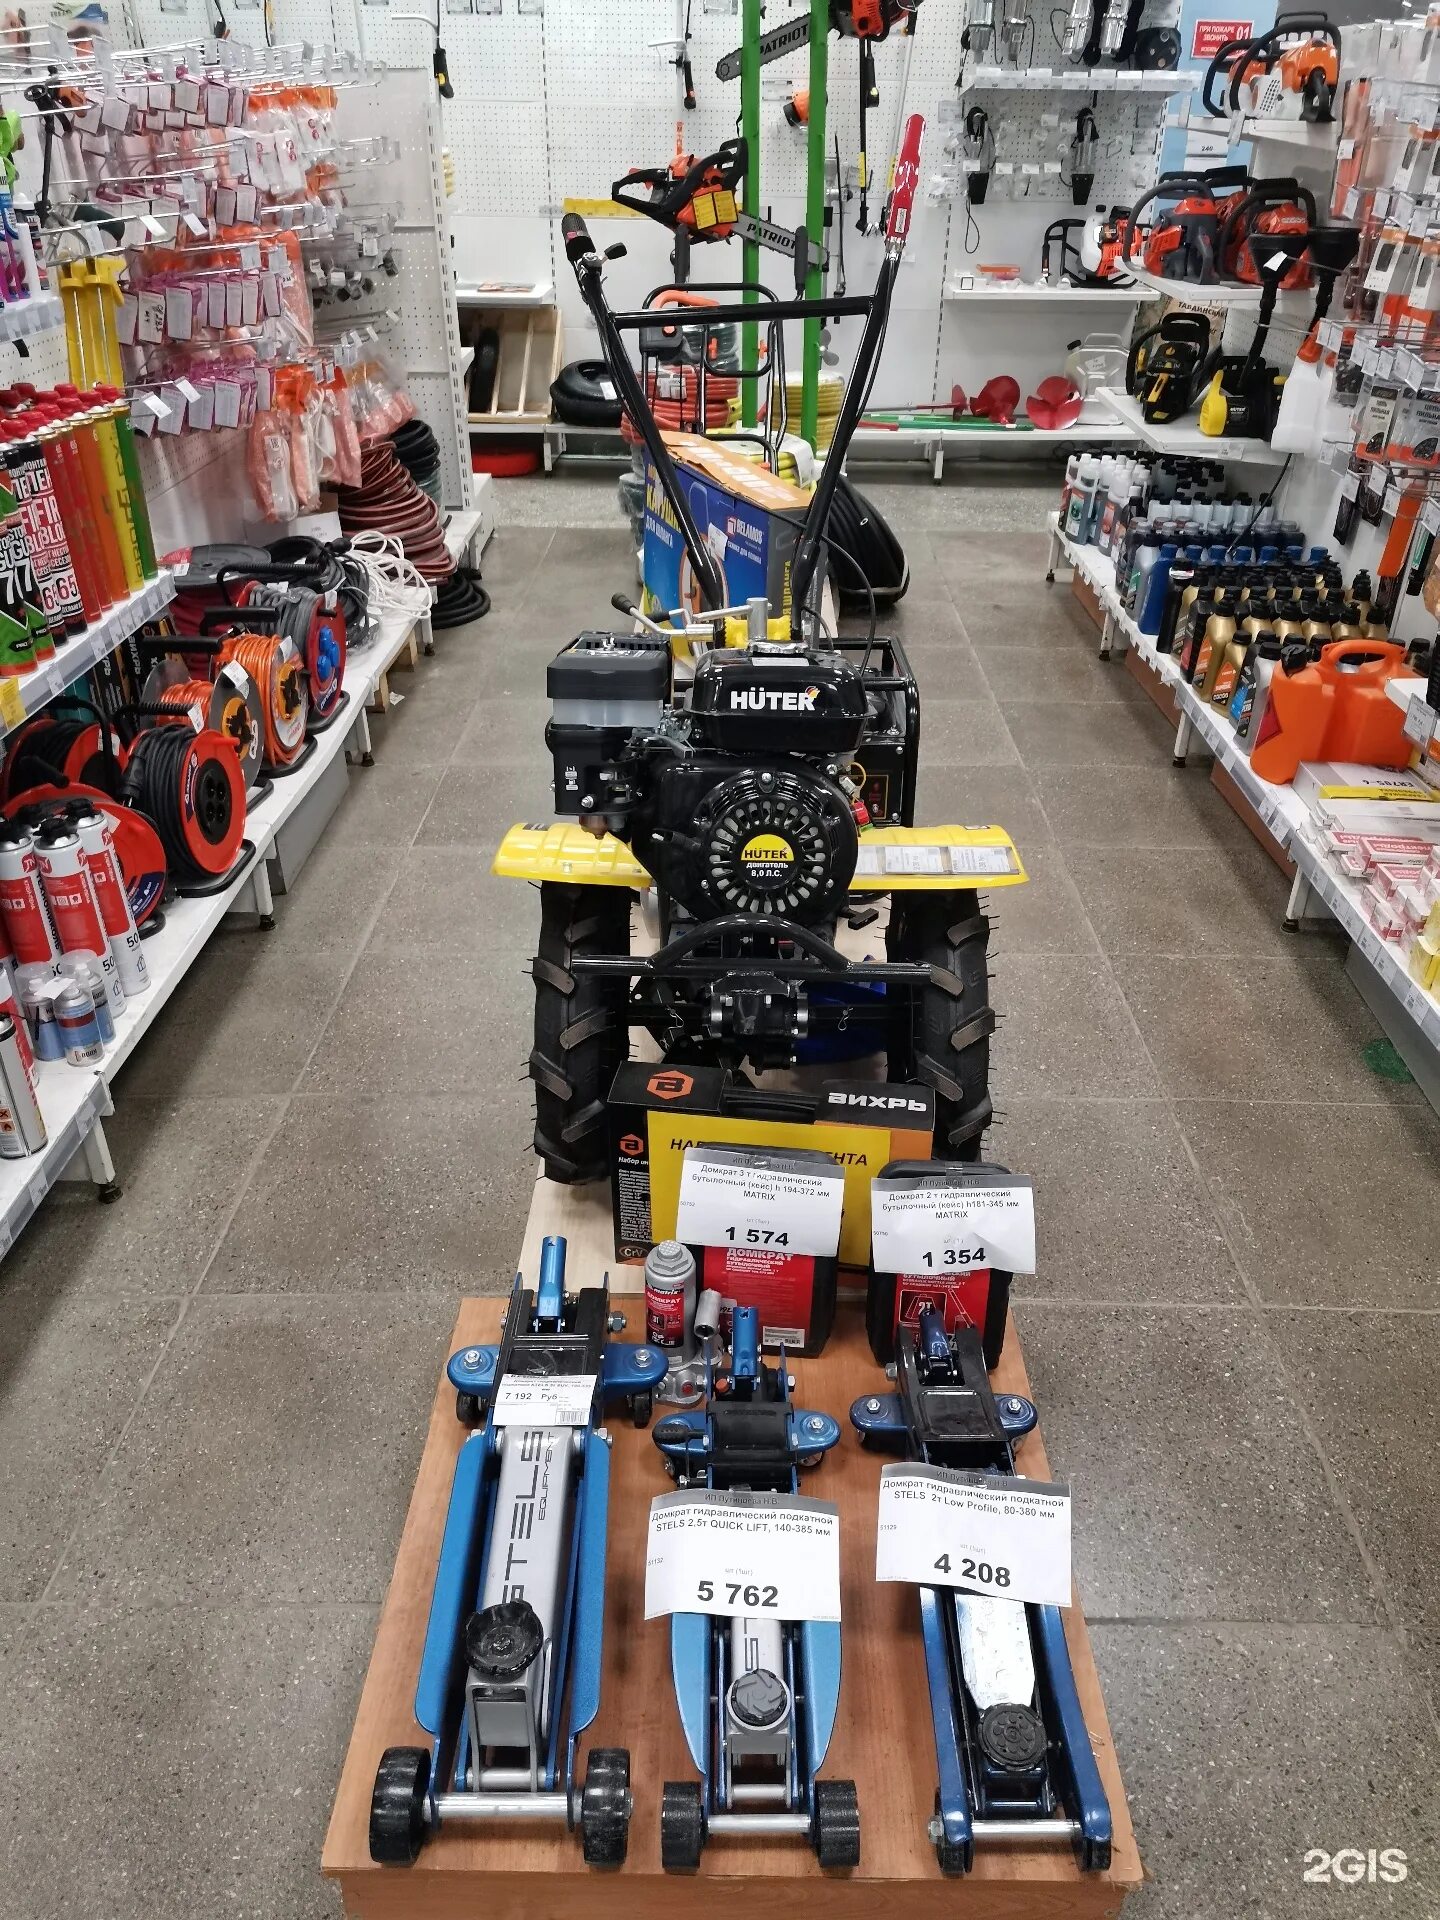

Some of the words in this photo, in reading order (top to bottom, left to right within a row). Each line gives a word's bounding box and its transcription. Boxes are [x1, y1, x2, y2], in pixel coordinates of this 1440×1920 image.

[1236, 26, 1250, 41] 01
[737, 518, 763, 545] BELAMOS
[730, 686, 816, 711] HÜTER
[744, 847, 788, 859] HÜTER
[746, 862, 789, 870] двигатель
[766, 869, 783, 878] Л.С.
[827, 1091, 928, 1113] ВИХРЬ
[700, 1164, 738, 1178] Домкрат
[739, 1169, 745, 1177] 3
[752, 1171, 823, 1187] гидравлический
[692, 1173, 746, 1188] бутылочный
[748, 1179, 773, 1192] (кейс)
[775, 1183, 781, 1192] h
[783, 1185, 815, 1197] 194-372
[816, 1190, 831, 1199] мм
[743, 1189, 776, 1201] MATRIX
[888, 1193, 924, 1202] Домкрат
[940, 1190, 1012, 1200] гидравлический
[882, 1202, 936, 1213] бутылочный
[938, 1201, 964, 1210] (кейс)
[966, 1200, 1004, 1208] h181-345
[935, 1210, 969, 1219] MATRIX
[725, 1226, 736, 1241] 1
[746, 1229, 790, 1247] 574
[727, 1247, 793, 1261] ДОМКРАТ
[922, 1251, 933, 1268] 1
[943, 1247, 986, 1266] 354
[504, 1392, 512, 1400] 7
[515, 1392, 532, 1400] 192
[541, 1393, 558, 1401] Руб
[538, 1431, 556, 1520] EQUIPMENT
[705, 1493, 717, 1501] ИП
[883, 1480, 924, 1490] Домкрат
[926, 1483, 1007, 1502] гидравлический
[1010, 1494, 1064, 1508] подкатной
[894, 1490, 926, 1500] STELS
[931, 1494, 942, 1503] 2т
[944, 1496, 964, 1508] Low
[967, 1500, 1001, 1515] Profile,
[1004, 1505, 1037, 1517] 80-380
[1039, 1511, 1055, 1519] мм
[652, 1507, 691, 1522] Домкрат
[693, 1508, 777, 1521] гидравлический
[779, 1512, 833, 1526] подкатной
[656, 1519, 685, 1533] STELS
[710, 1520, 744, 1532] QUICK
[746, 1522, 771, 1534] LIFT,
[774, 1523, 813, 1534] 140-385
[815, 1528, 831, 1537] мм
[933, 1553, 952, 1574] 4
[962, 1558, 1011, 1588] 208
[697, 1580, 714, 1602] 5
[725, 1582, 779, 1608] 762
